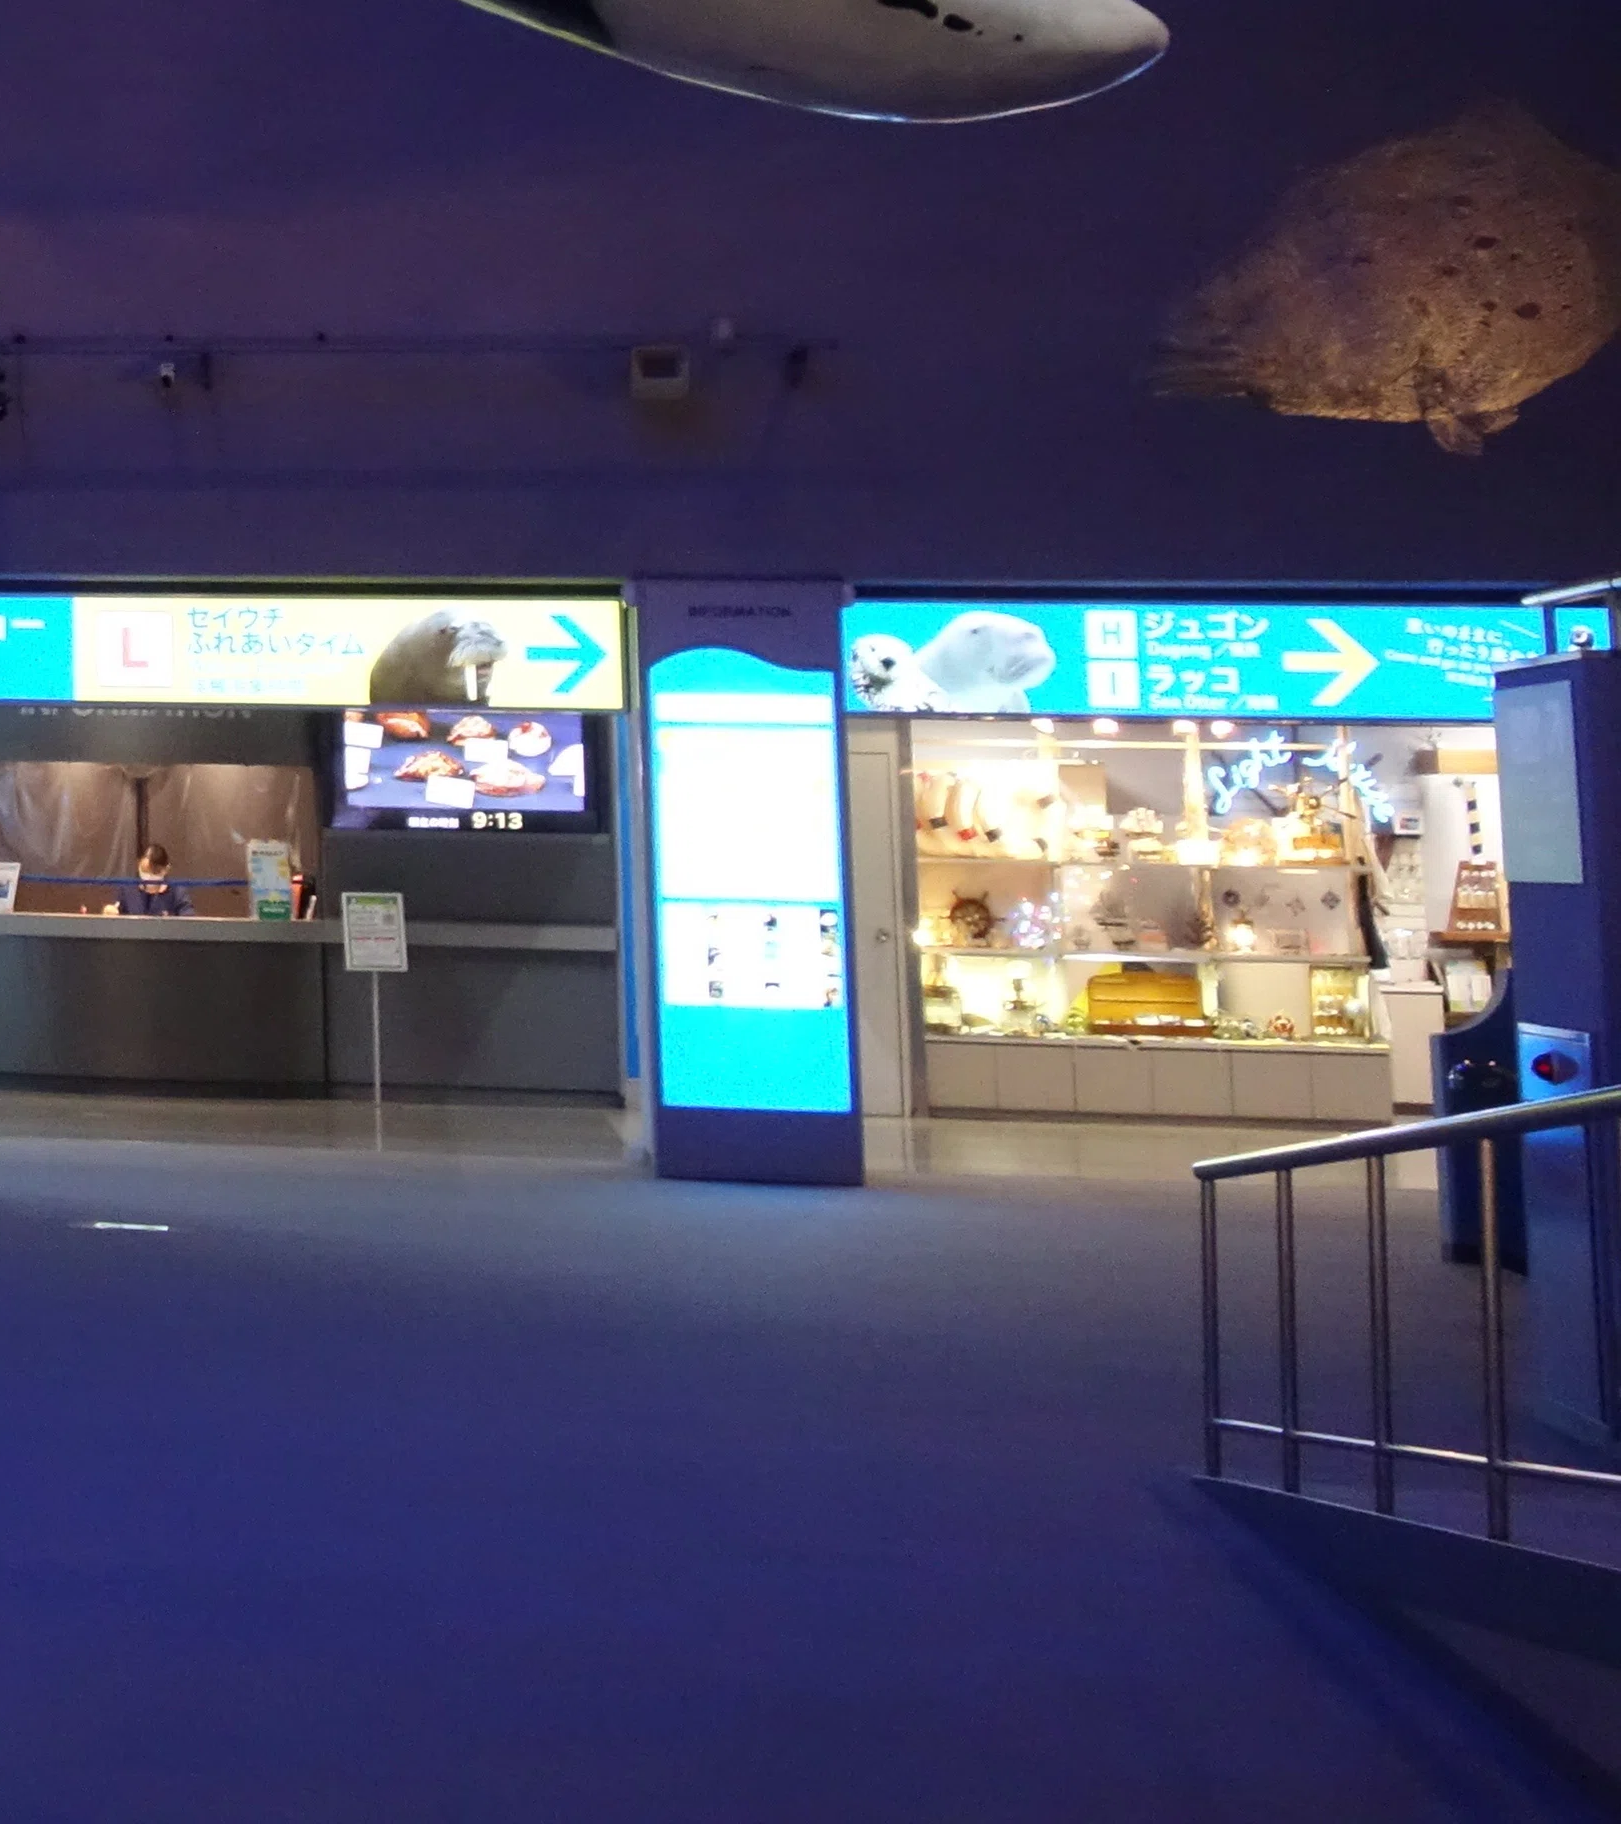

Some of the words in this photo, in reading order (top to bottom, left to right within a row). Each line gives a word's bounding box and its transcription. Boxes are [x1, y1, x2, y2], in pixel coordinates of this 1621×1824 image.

[187, 606, 284, 629] セイウチ
[1143, 610, 1271, 641] ジュゴン
[188, 632, 365, 656] ふれあいタイム
[1101, 620, 1121, 645] H
[122, 627, 150, 669] L
[1145, 663, 1241, 694] ラッコ
[471, 811, 524, 831] 9:13
